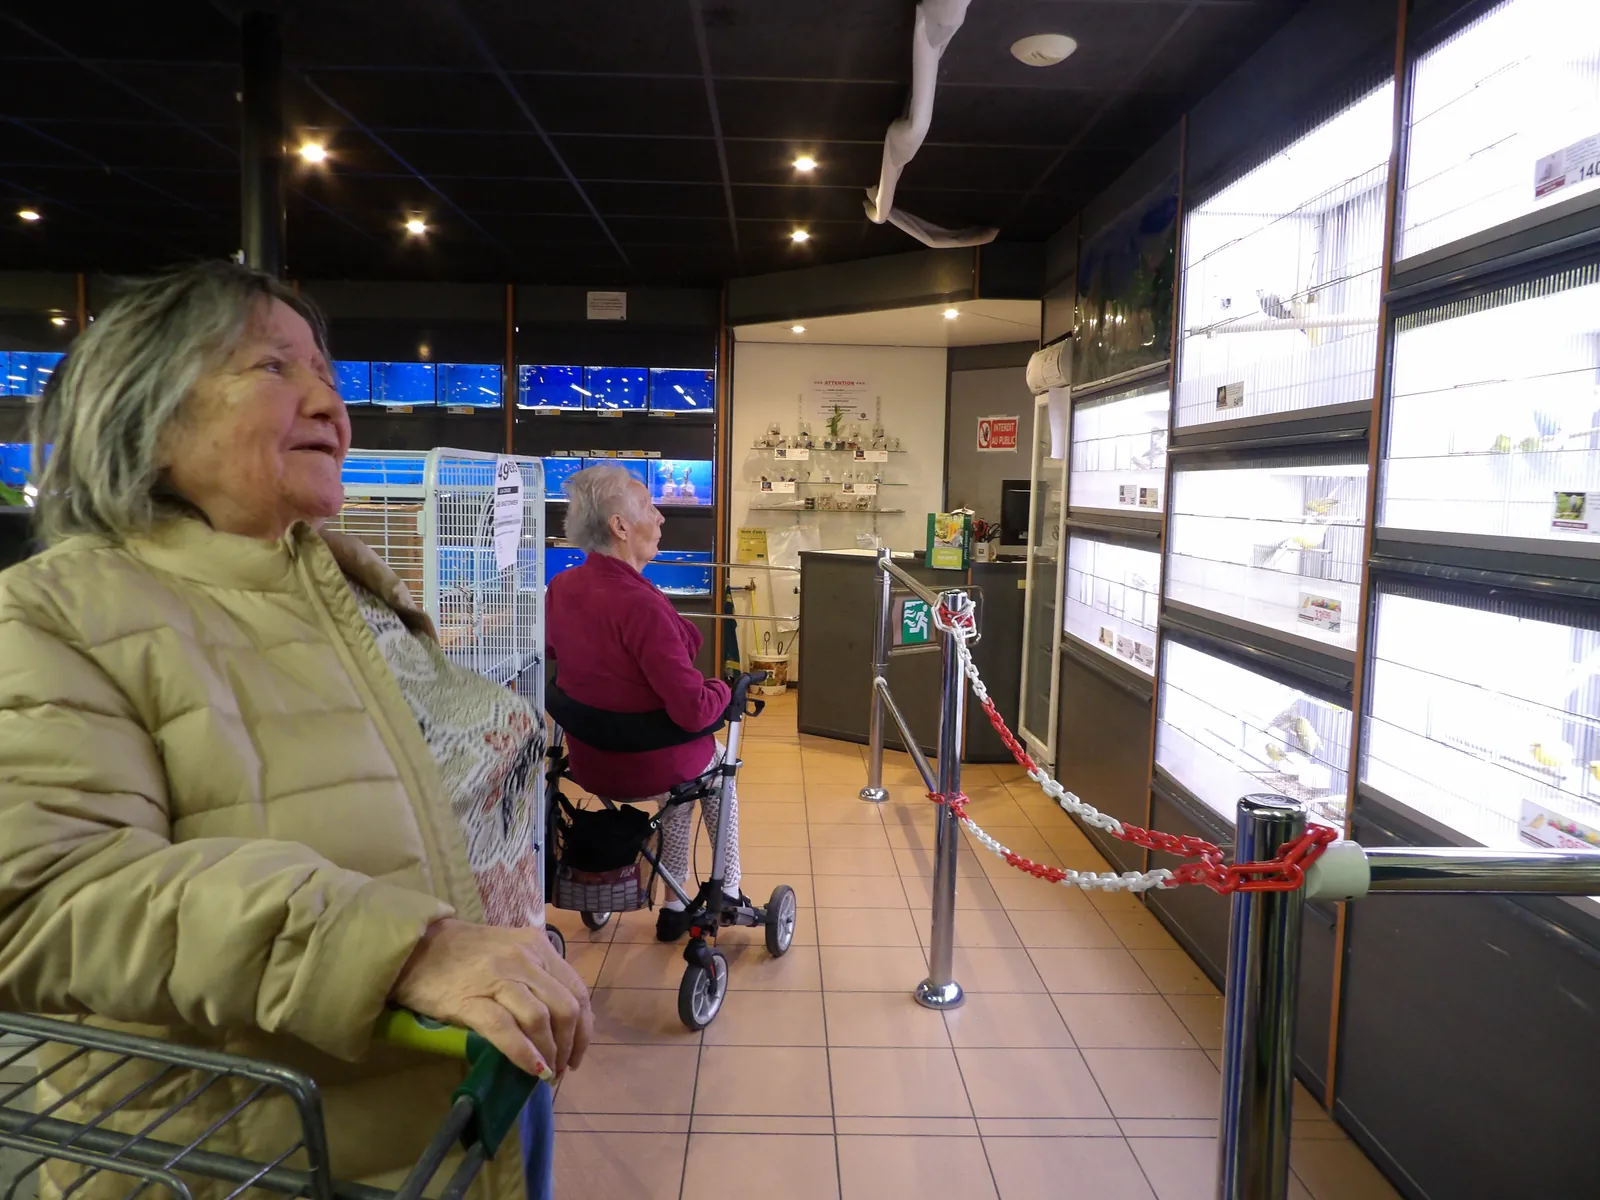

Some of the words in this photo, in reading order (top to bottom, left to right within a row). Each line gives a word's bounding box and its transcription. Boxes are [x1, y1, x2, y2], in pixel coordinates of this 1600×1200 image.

[993, 422, 1016, 432] INTERDIT
[991, 436, 999, 445] AU
[999, 435, 1016, 445] PUBLIC
